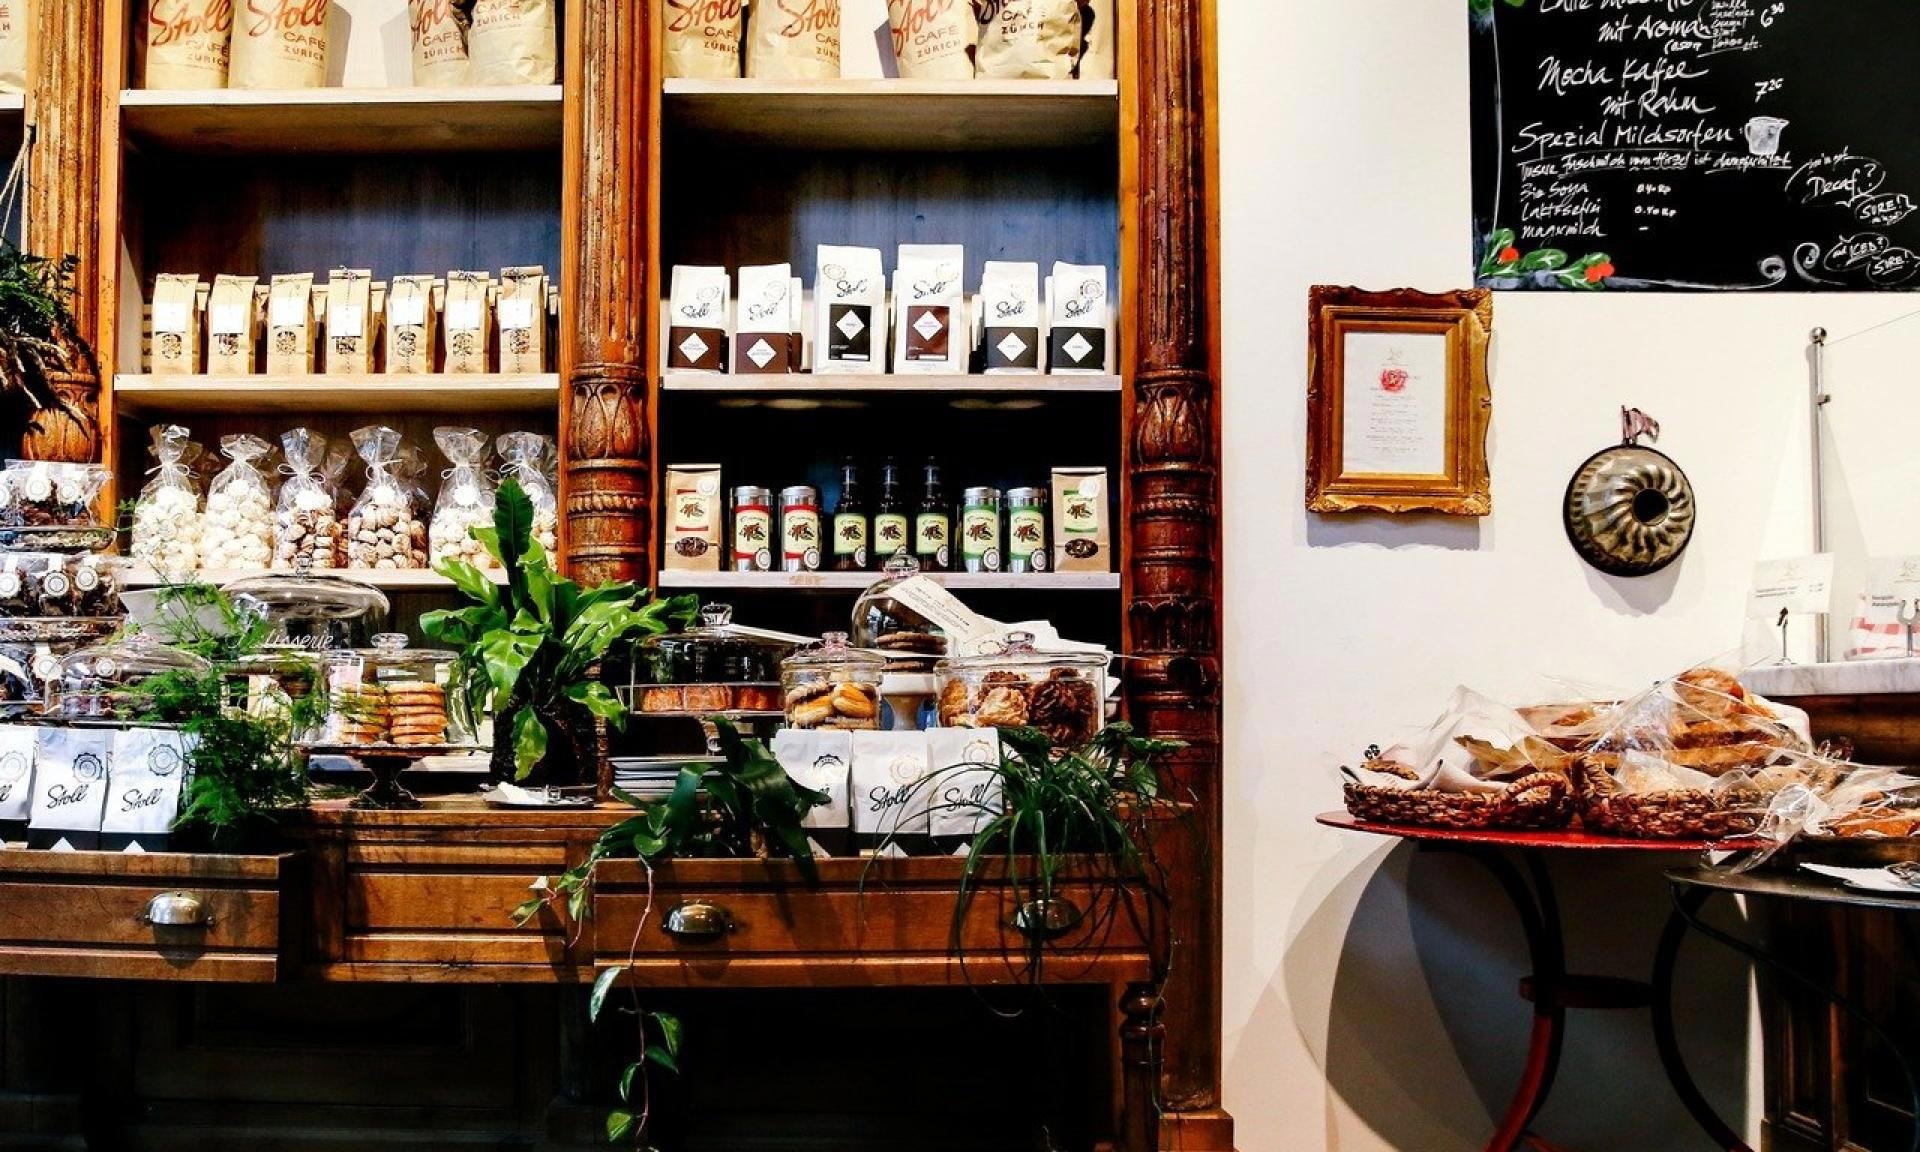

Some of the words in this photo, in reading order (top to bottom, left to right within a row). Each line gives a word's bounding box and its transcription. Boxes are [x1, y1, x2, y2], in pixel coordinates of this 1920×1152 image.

[1598, 13, 1632, 43] mit
[1511, 120, 1609, 160] Spezial
[46, 784, 89, 809] Stoll
[121, 788, 163, 812] Stoll
[869, 785, 913, 812] Stoll
